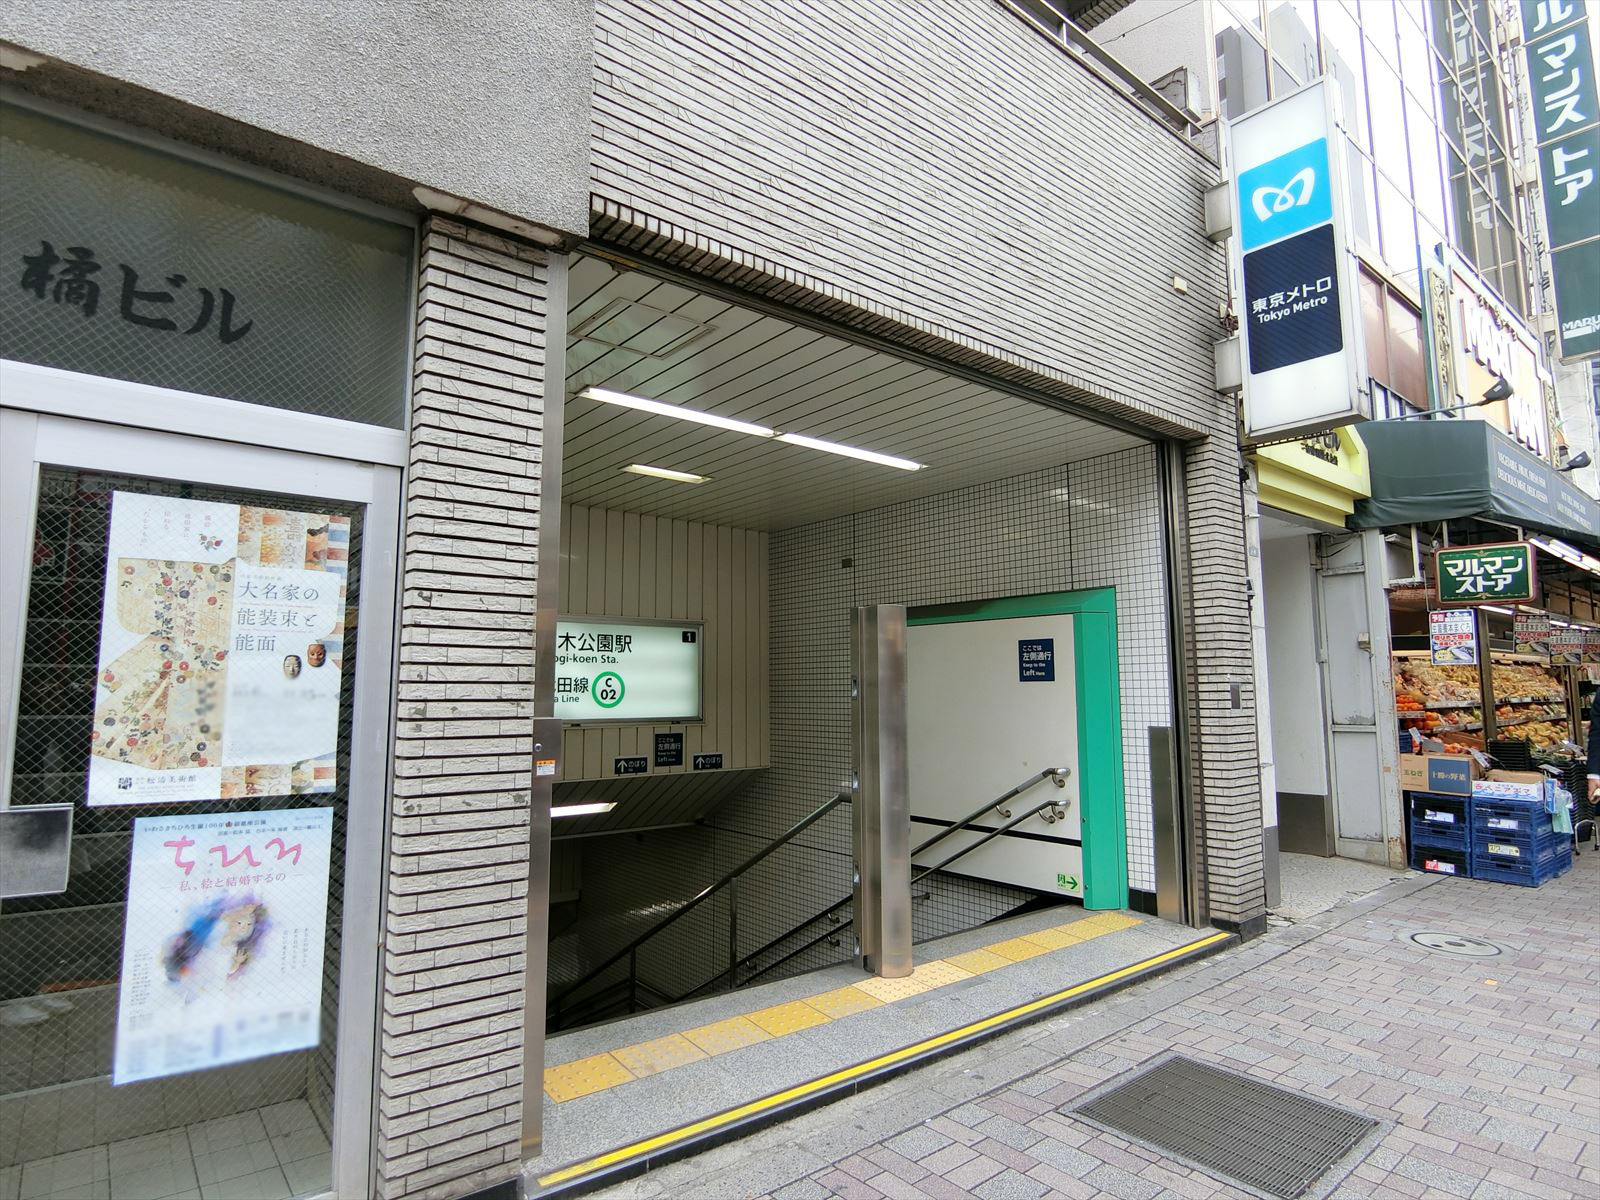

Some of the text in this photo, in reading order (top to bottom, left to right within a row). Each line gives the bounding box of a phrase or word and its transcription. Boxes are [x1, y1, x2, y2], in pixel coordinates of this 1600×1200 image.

[21, 240, 253, 344] 橘ビル
[1251, 276, 1331, 314] 東京メトロ
[1257, 296, 1328, 323] Tokyo Metro
[1443, 556, 1523, 576] マルマン
[239, 581, 319, 601] 大名家の
[1455, 574, 1512, 594] ストア
[237, 608, 317, 628] 能装束と
[235, 633, 277, 652] 能面
[558, 632, 632, 653] 木公園駅
[686, 632, 692, 642] 1
[600, 654, 619, 664] Sta.
[1022, 651, 1052, 661] 左側通行
[605, 678, 612, 688] C
[561, 695, 580, 703] Line
[600, 689, 617, 700] 02
[163, 835, 303, 877] ちひろ
[178, 872, 287, 892] 私、絵と結婚するの
